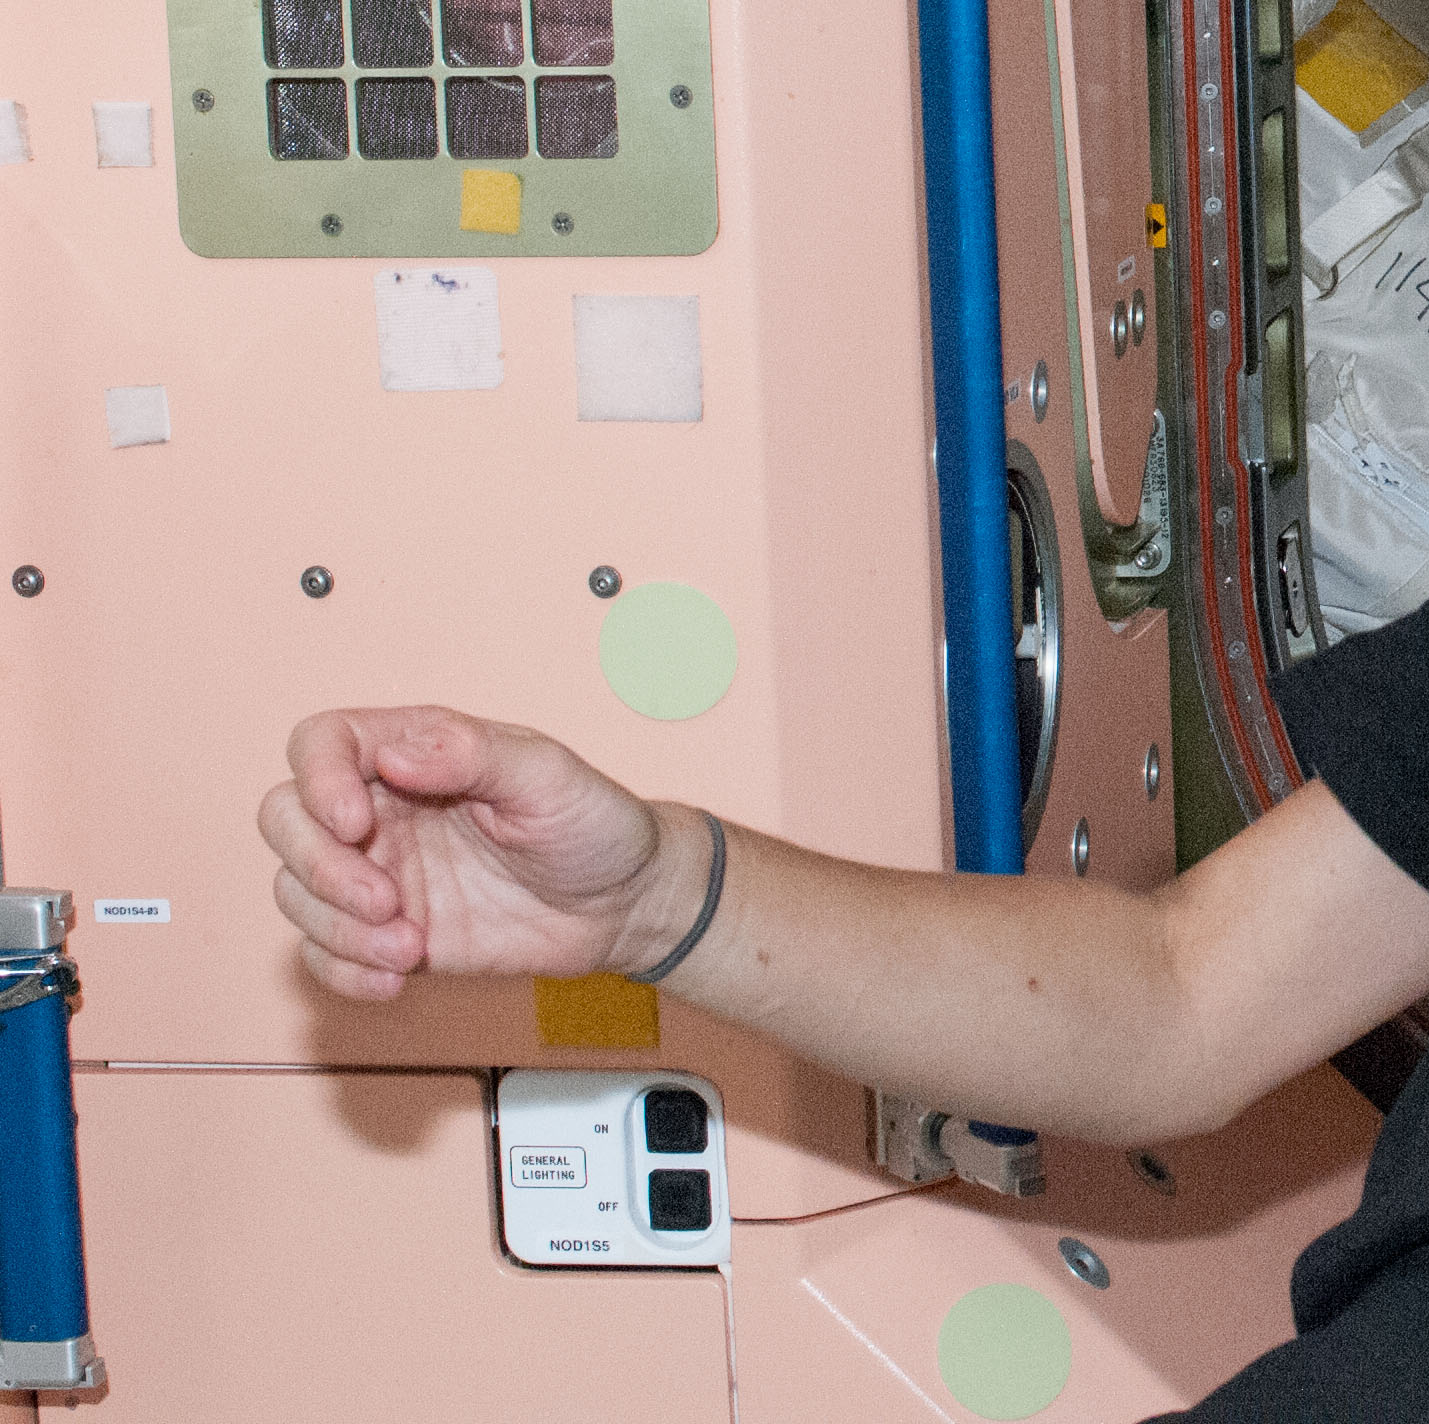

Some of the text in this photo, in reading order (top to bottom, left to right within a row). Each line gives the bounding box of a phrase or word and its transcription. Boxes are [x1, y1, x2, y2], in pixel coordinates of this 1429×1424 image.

[594, 1124, 609, 1134] ON
[521, 1156, 571, 1166] GENERAL
[522, 1170, 575, 1180] LIGHTING
[598, 1201, 619, 1212] OFF
[549, 1239, 610, 1252] NOD1S5
